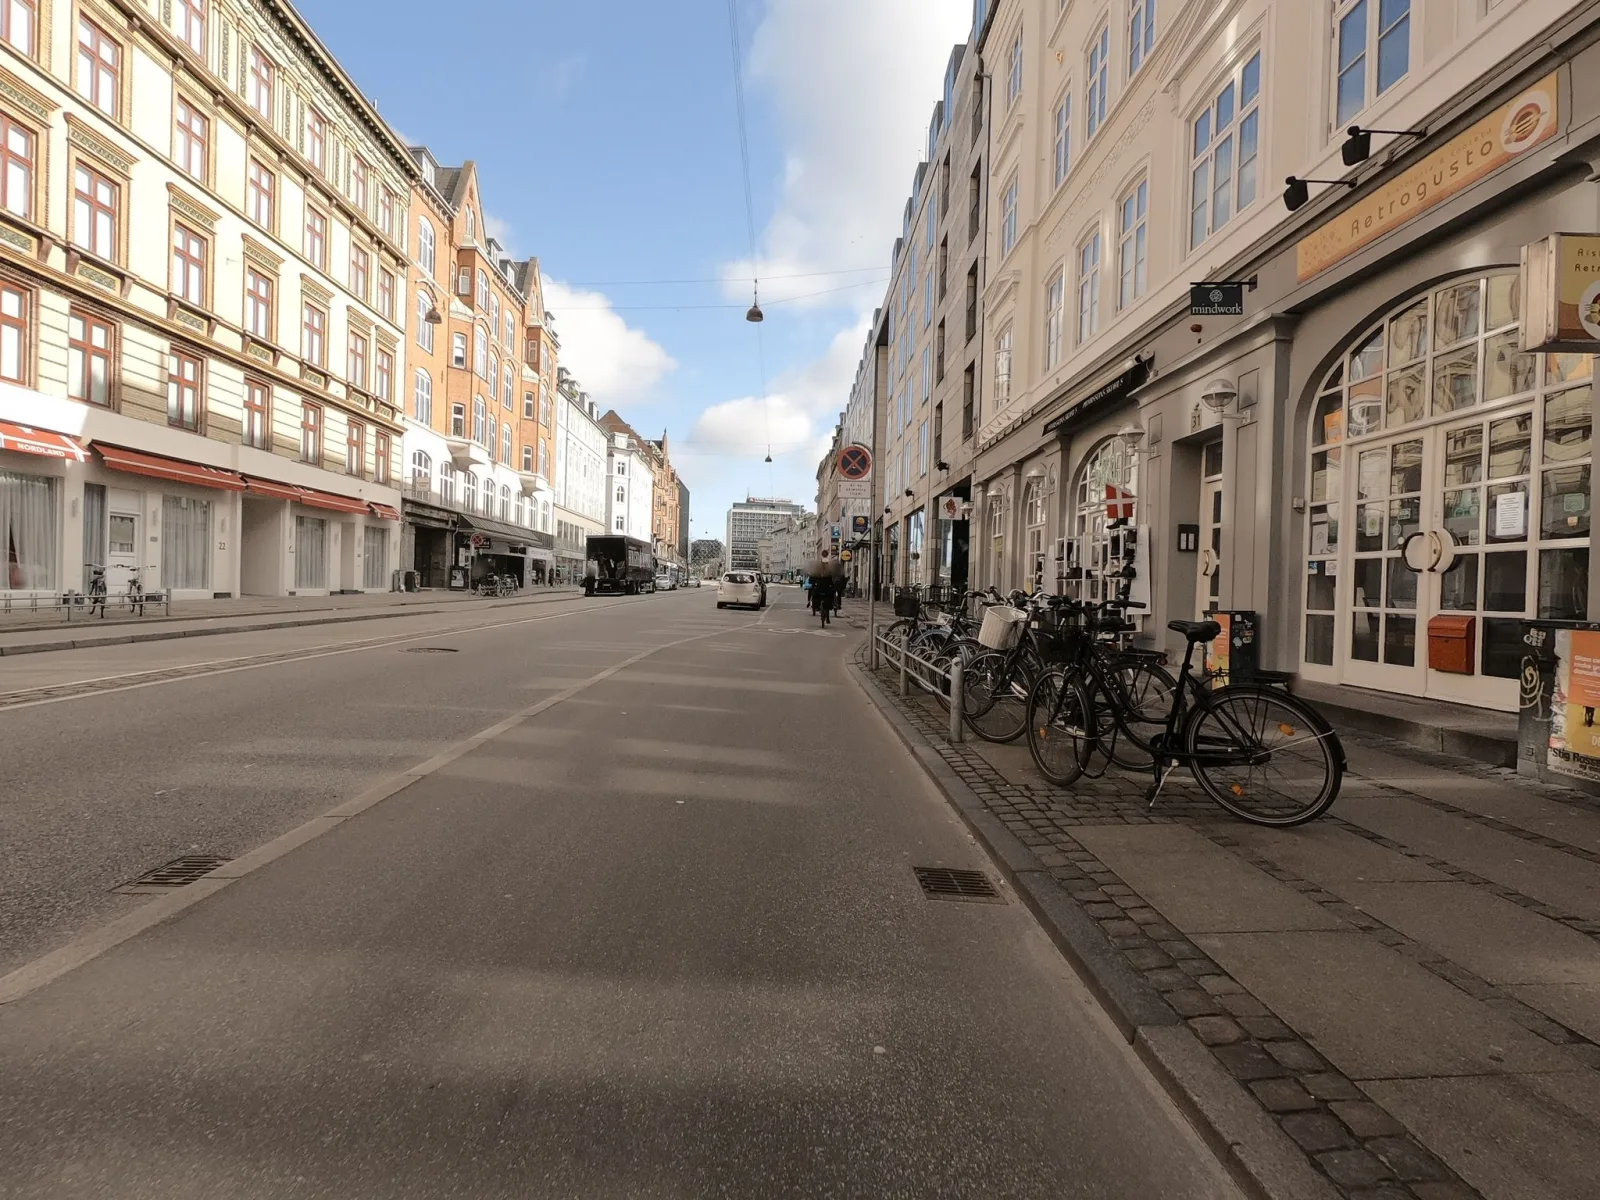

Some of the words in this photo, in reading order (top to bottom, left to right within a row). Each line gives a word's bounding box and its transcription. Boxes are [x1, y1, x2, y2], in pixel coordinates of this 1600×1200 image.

[1350, 140, 1493, 238] Retrogusto
[1577, 248, 1600, 256] Ris
[1192, 303, 1242, 314] mindwork
[1192, 413, 1201, 428] 31
[17, 442, 66, 457] NORDLAND
[218, 541, 226, 550] 22
[1552, 747, 1570, 762] Stig
